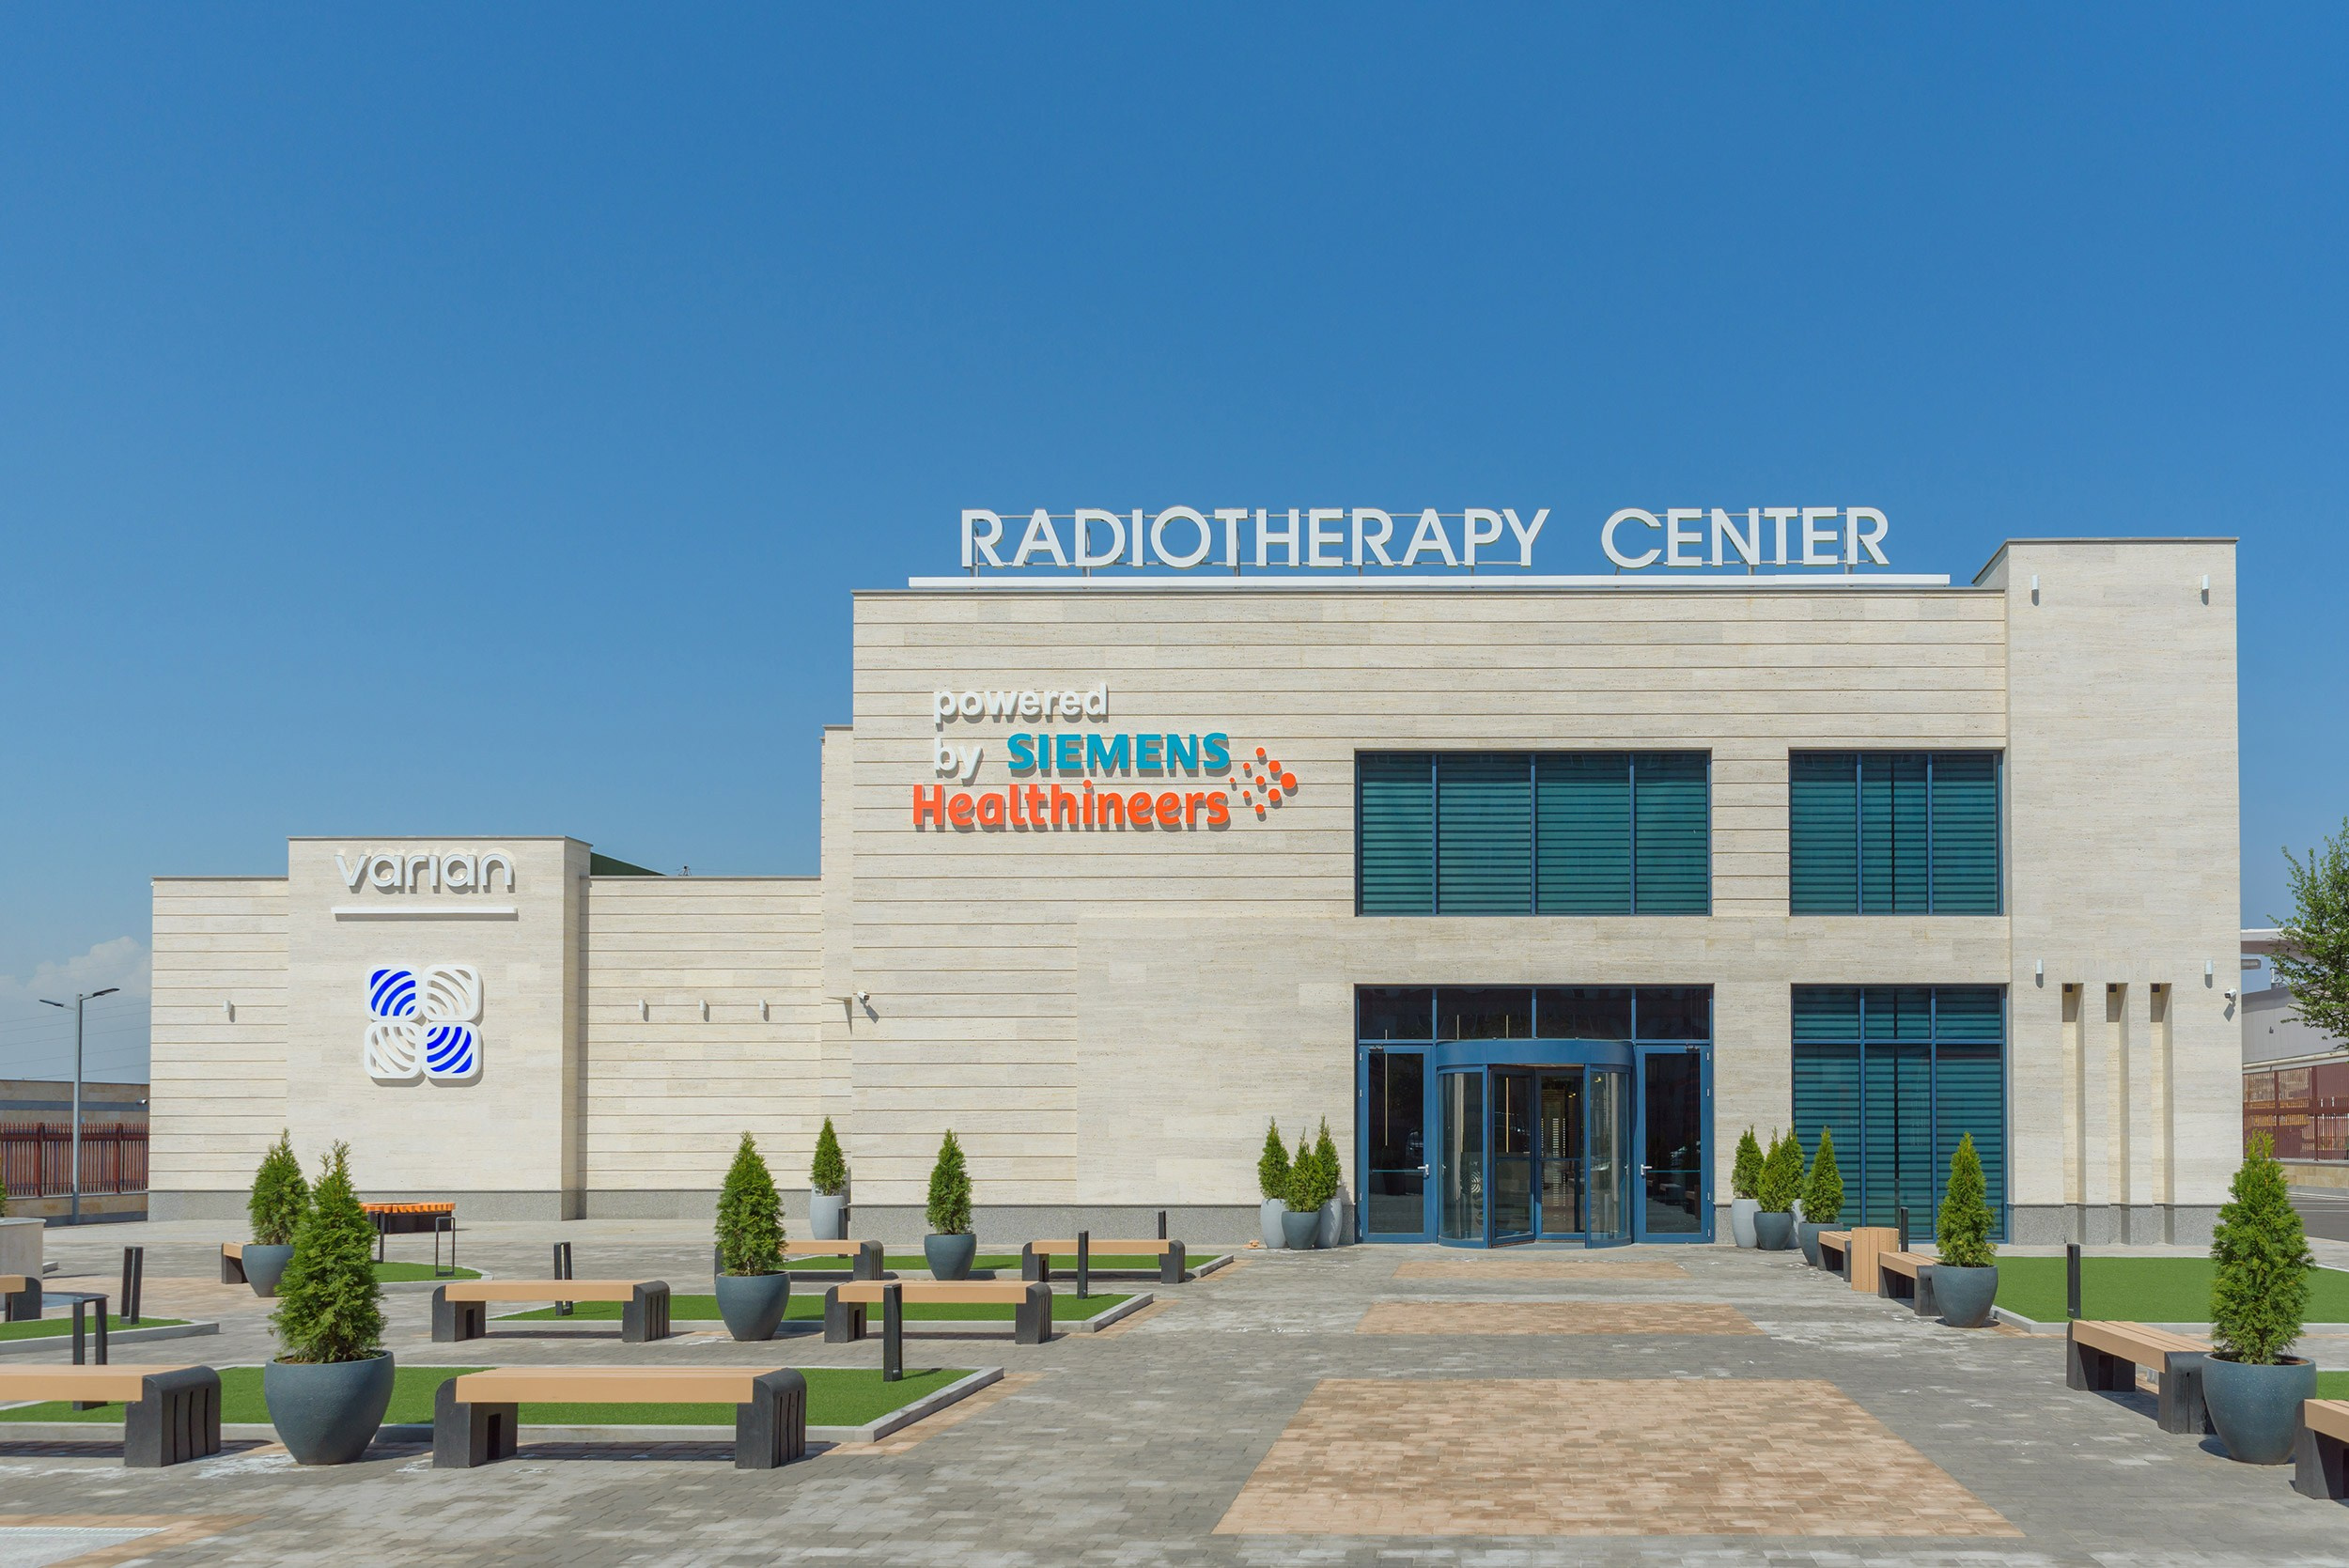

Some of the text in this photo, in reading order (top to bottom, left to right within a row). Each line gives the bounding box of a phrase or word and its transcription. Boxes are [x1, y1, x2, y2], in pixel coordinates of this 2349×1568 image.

[960, 505, 1890, 568] RADIOTHERAPY CENTER
[934, 683, 1108, 723] powered
[934, 733, 1230, 780] by SIEMENS
[913, 780, 1230, 826] Healthineers
[334, 854, 513, 887] varian
